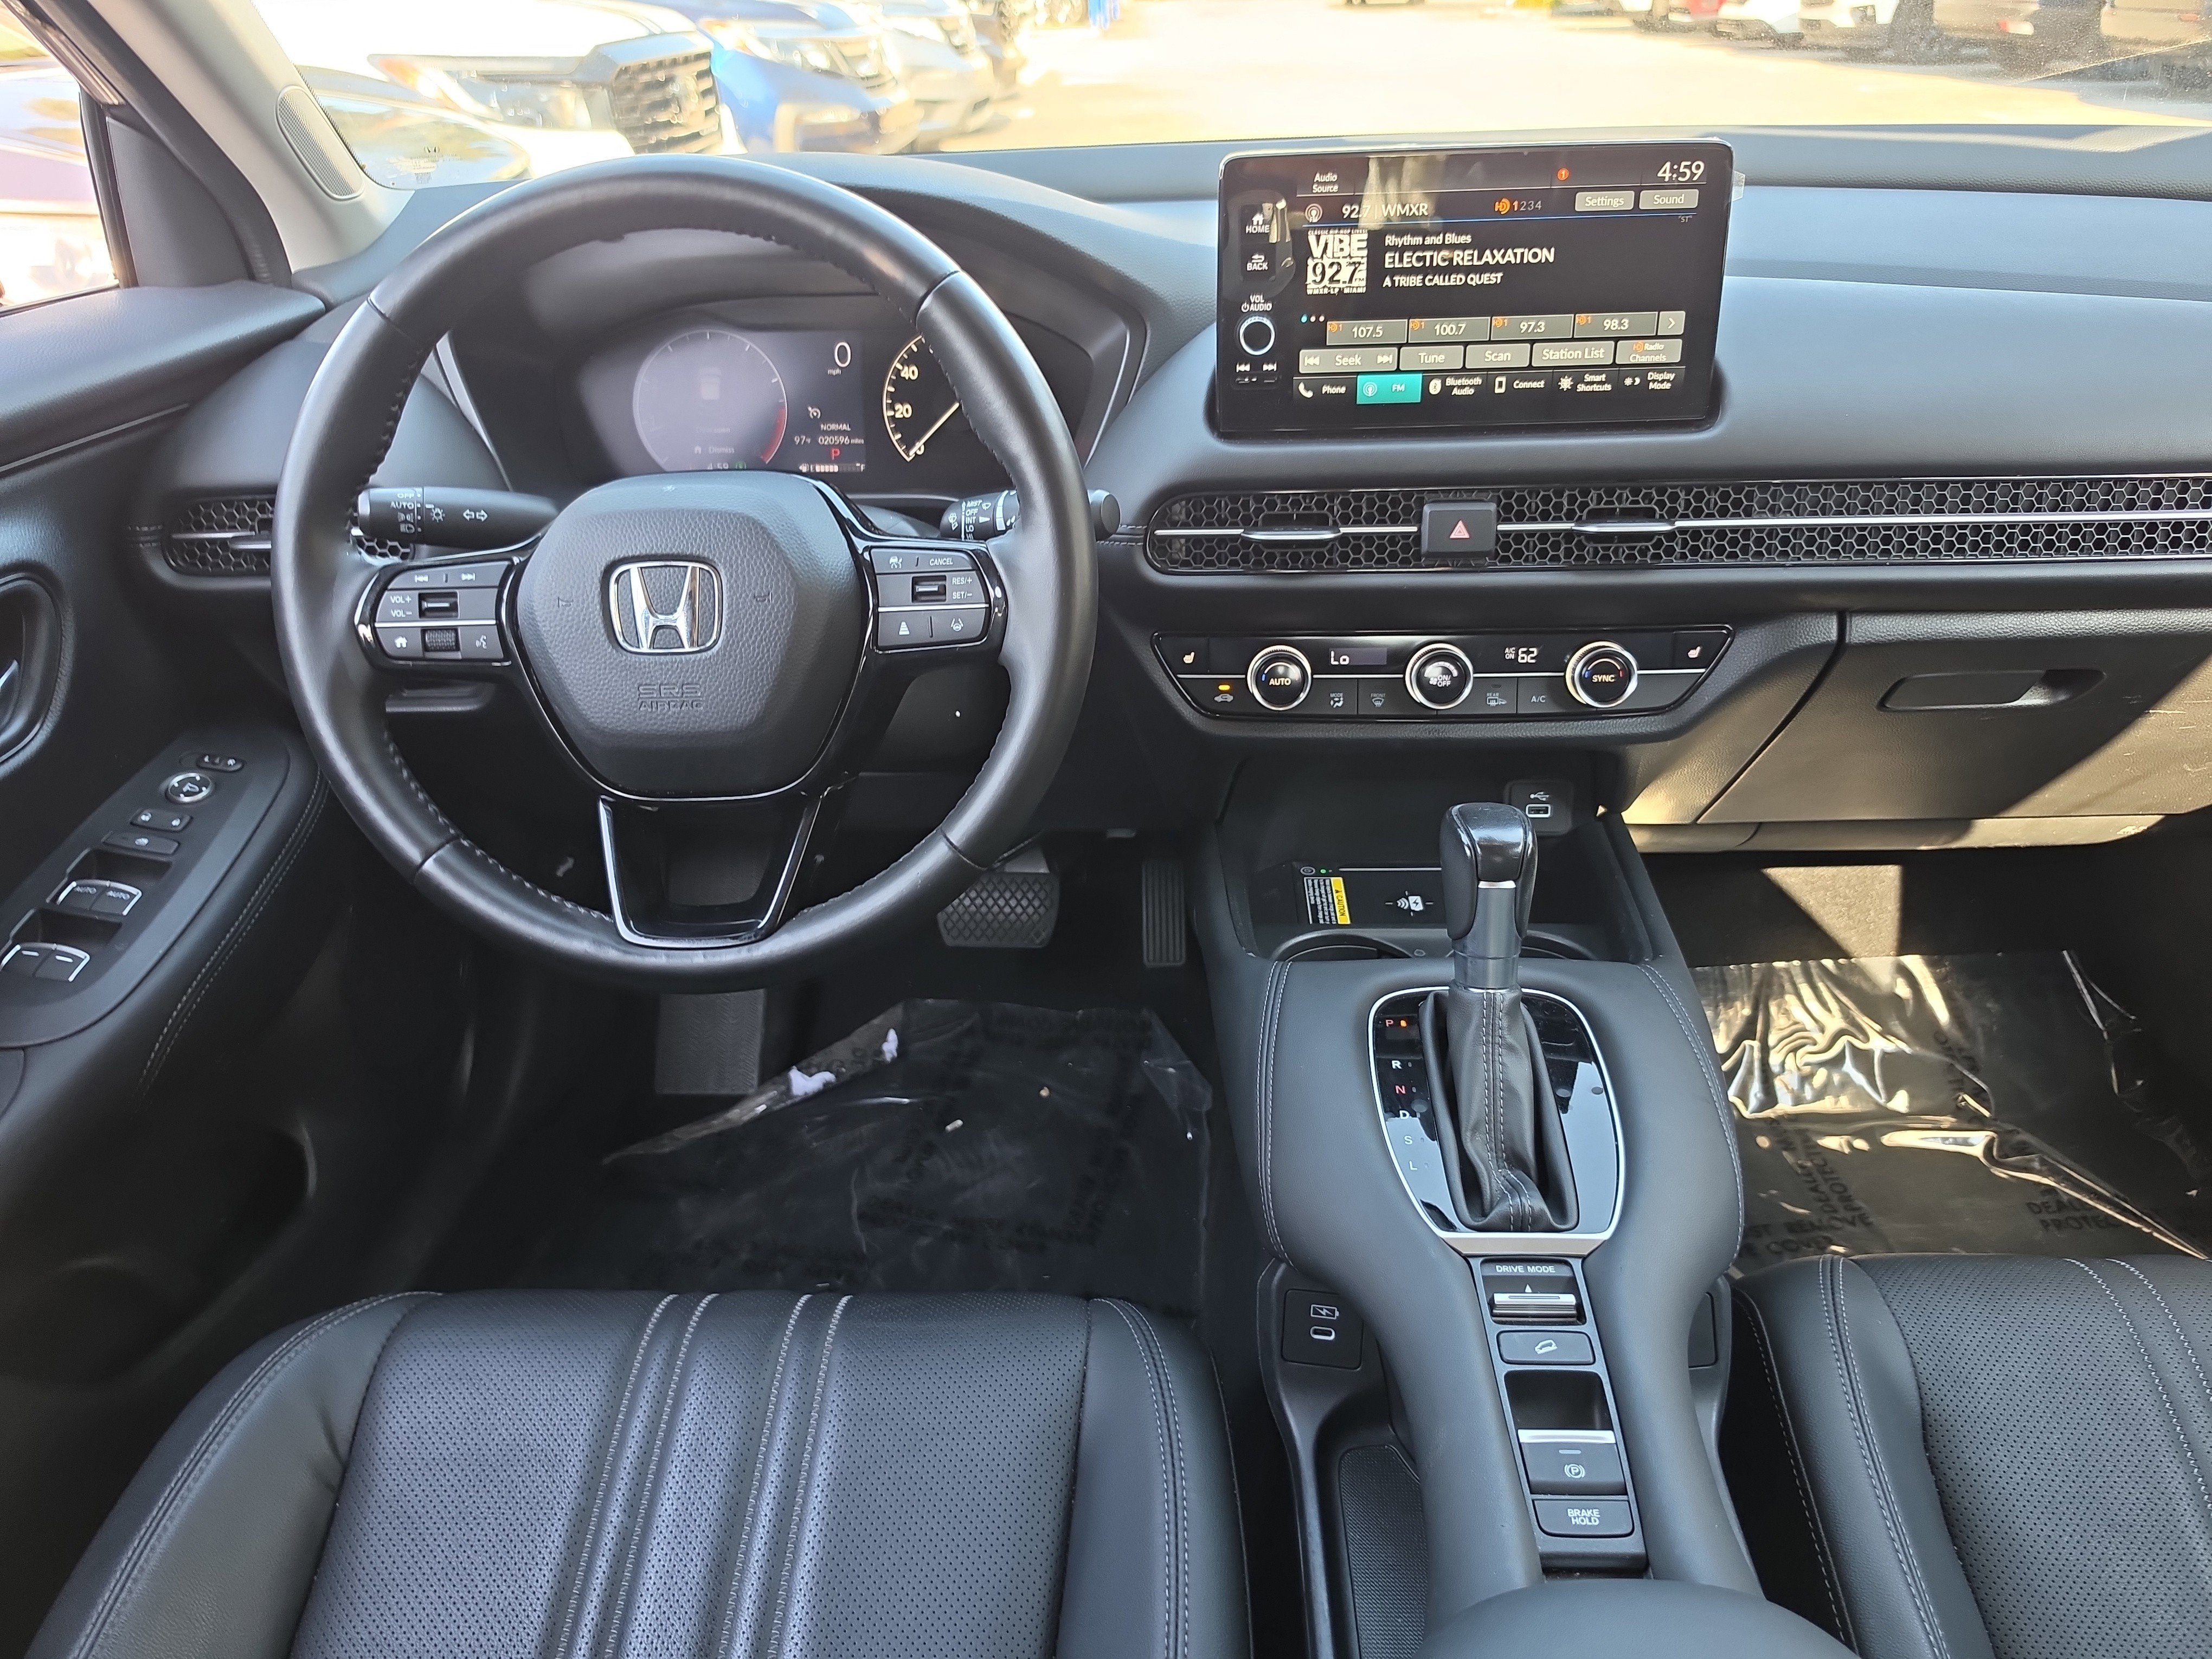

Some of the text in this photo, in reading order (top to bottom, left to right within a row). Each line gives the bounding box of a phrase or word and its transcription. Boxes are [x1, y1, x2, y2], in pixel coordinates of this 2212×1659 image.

[1657, 160, 1705, 182] 4:59
[1314, 172, 1338, 183] Audio
[1313, 184, 1338, 193] Source
[1585, 195, 1624, 207] Settings
[1653, 194, 1684, 205] Sound
[1342, 203, 1429, 219] 92.7 WMXR
[1245, 224, 1270, 234] HOME
[1385, 233, 1472, 247] Rhythm and Blues
[1308, 234, 1368, 259] VIBE
[1384, 247, 1555, 269] ELECTIC RELAXATION
[1246, 262, 1269, 271] BACK
[1312, 261, 1361, 285] 92.7
[1382, 272, 1503, 288] A TRIBE CALLED QUEST
[1250, 295, 1265, 303] VOL
[1249, 302, 1272, 312] AUDIO
[1434, 323, 1467, 336] 100.7
[1520, 320, 1545, 333] 97.3
[1603, 318, 1629, 331] 98.3
[1352, 326, 1383, 338] 107.5
[1644, 343, 1664, 351] Radio
[834, 342, 852, 368] 0
[1418, 352, 1445, 364] Tune
[1484, 350, 1511, 362] Scan
[1542, 347, 1605, 361] Station List
[1629, 353, 1667, 363] Channels
[1335, 354, 1362, 366] Seek
[901, 365, 919, 381] 40
[1583, 373, 1606, 382] Smart
[1647, 371, 1676, 382] Display
[1445, 376, 1482, 387] Bluetooth
[1513, 380, 1546, 389] Connect
[1649, 381, 1672, 391] Mode
[1322, 385, 1347, 395] Phone
[1391, 383, 1405, 393] FM
[1451, 386, 1475, 396] Audio
[1576, 383, 1612, 393] Shortcuts
[894, 403, 912, 419] 20
[820, 423, 851, 431] NORMAL
[818, 435, 850, 445] 020596
[708, 446, 735, 454] Dismiss
[831, 447, 840, 461] P
[966, 499, 982, 507] MIST
[966, 524, 974, 532] LO
[929, 557, 953, 565] CANCEL
[1518, 647, 1538, 664] 62
[1269, 677, 1291, 686] AUTO
[1592, 674, 1615, 683] SYNC
[638, 684, 701, 698] SRS
[1531, 695, 1546, 703] A/C
[1336, 895, 1346, 916] CAUTION
[1392, 1060, 1402, 1069] R
[1396, 1086, 1406, 1094] N
[1399, 1110, 1410, 1119] D
[1404, 1136, 1413, 1145] S
[1409, 1161, 1418, 1171] L
[1495, 1265, 1555, 1273] DRIVE MODE
[1567, 1508, 1600, 1517] BRAKE
[1571, 1516, 1599, 1526] HOLD
